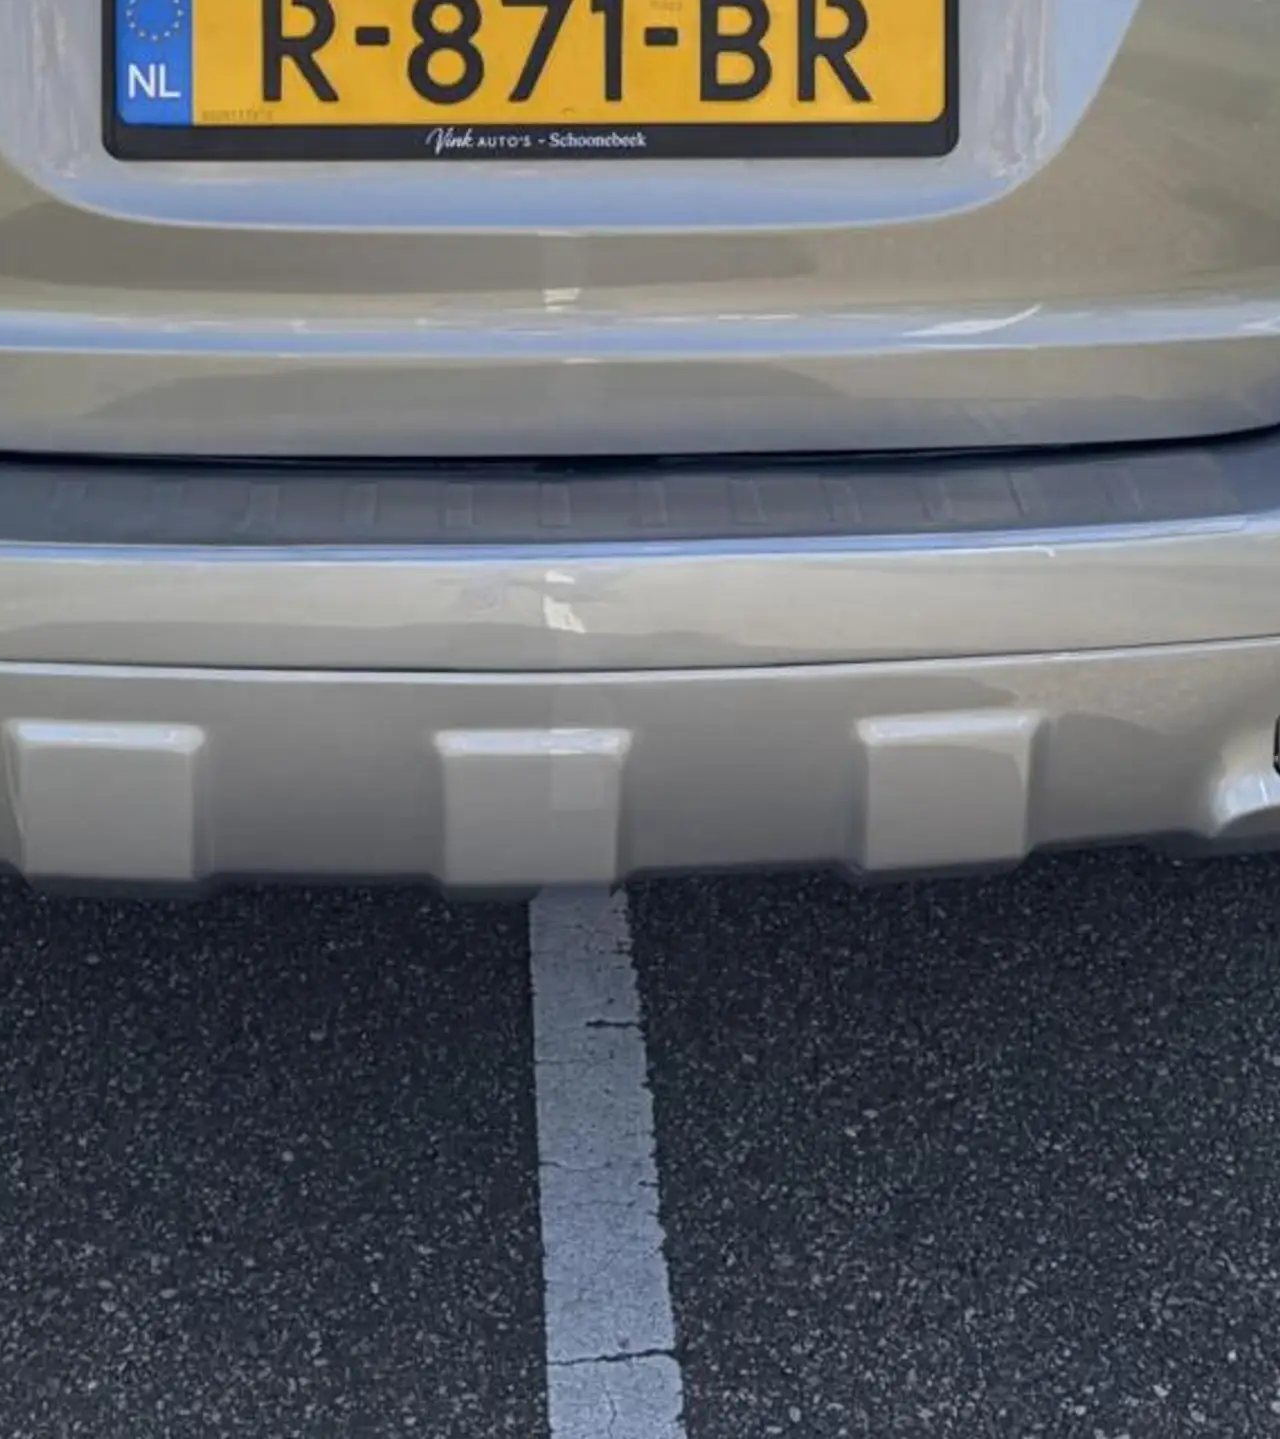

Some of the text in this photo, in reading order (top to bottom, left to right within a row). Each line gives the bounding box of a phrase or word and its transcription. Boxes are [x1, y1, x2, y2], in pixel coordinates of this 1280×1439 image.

[128, 64, 180, 100] NL
[425, 127, 474, 155] Vink
[477, 134, 532, 148] AUTO'S
[549, 132, 646, 147] Schoonebeek
